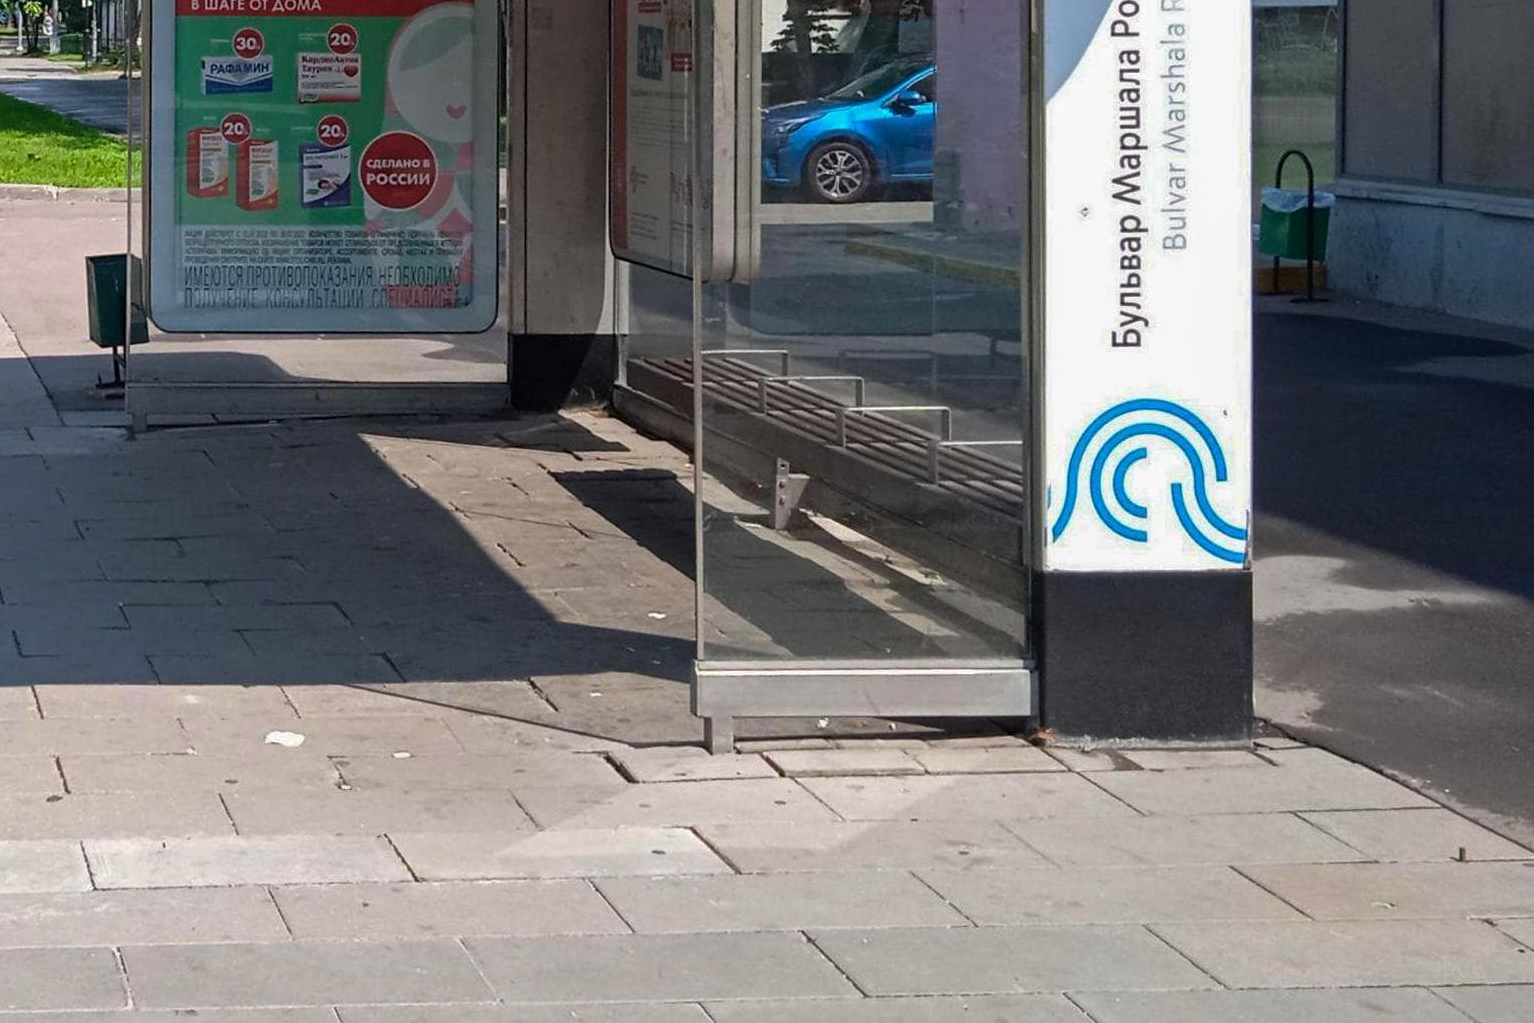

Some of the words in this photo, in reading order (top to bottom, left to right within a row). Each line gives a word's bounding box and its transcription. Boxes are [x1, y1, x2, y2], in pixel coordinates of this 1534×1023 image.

[210, 62, 270, 75] РАФАМИН
[1160, 24, 1186, 154] Marshala
[1111, 48, 1148, 206] Маршала
[366, 159, 420, 169] СДЕЛАНО
[423, 159, 431, 168] В
[366, 173, 431, 185] РОССИИ
[1160, 163, 1186, 250] Bulvar
[185, 265, 243, 287] ИМЕЮТСЯ
[378, 265, 461, 287] НЕОБХОДИМО
[1111, 214, 1148, 348] Бульвар
[185, 287, 258, 308] ПОЛУЧЕНИЕ
[266, 287, 364, 308] КОНСУЛЬТАЦИИ
